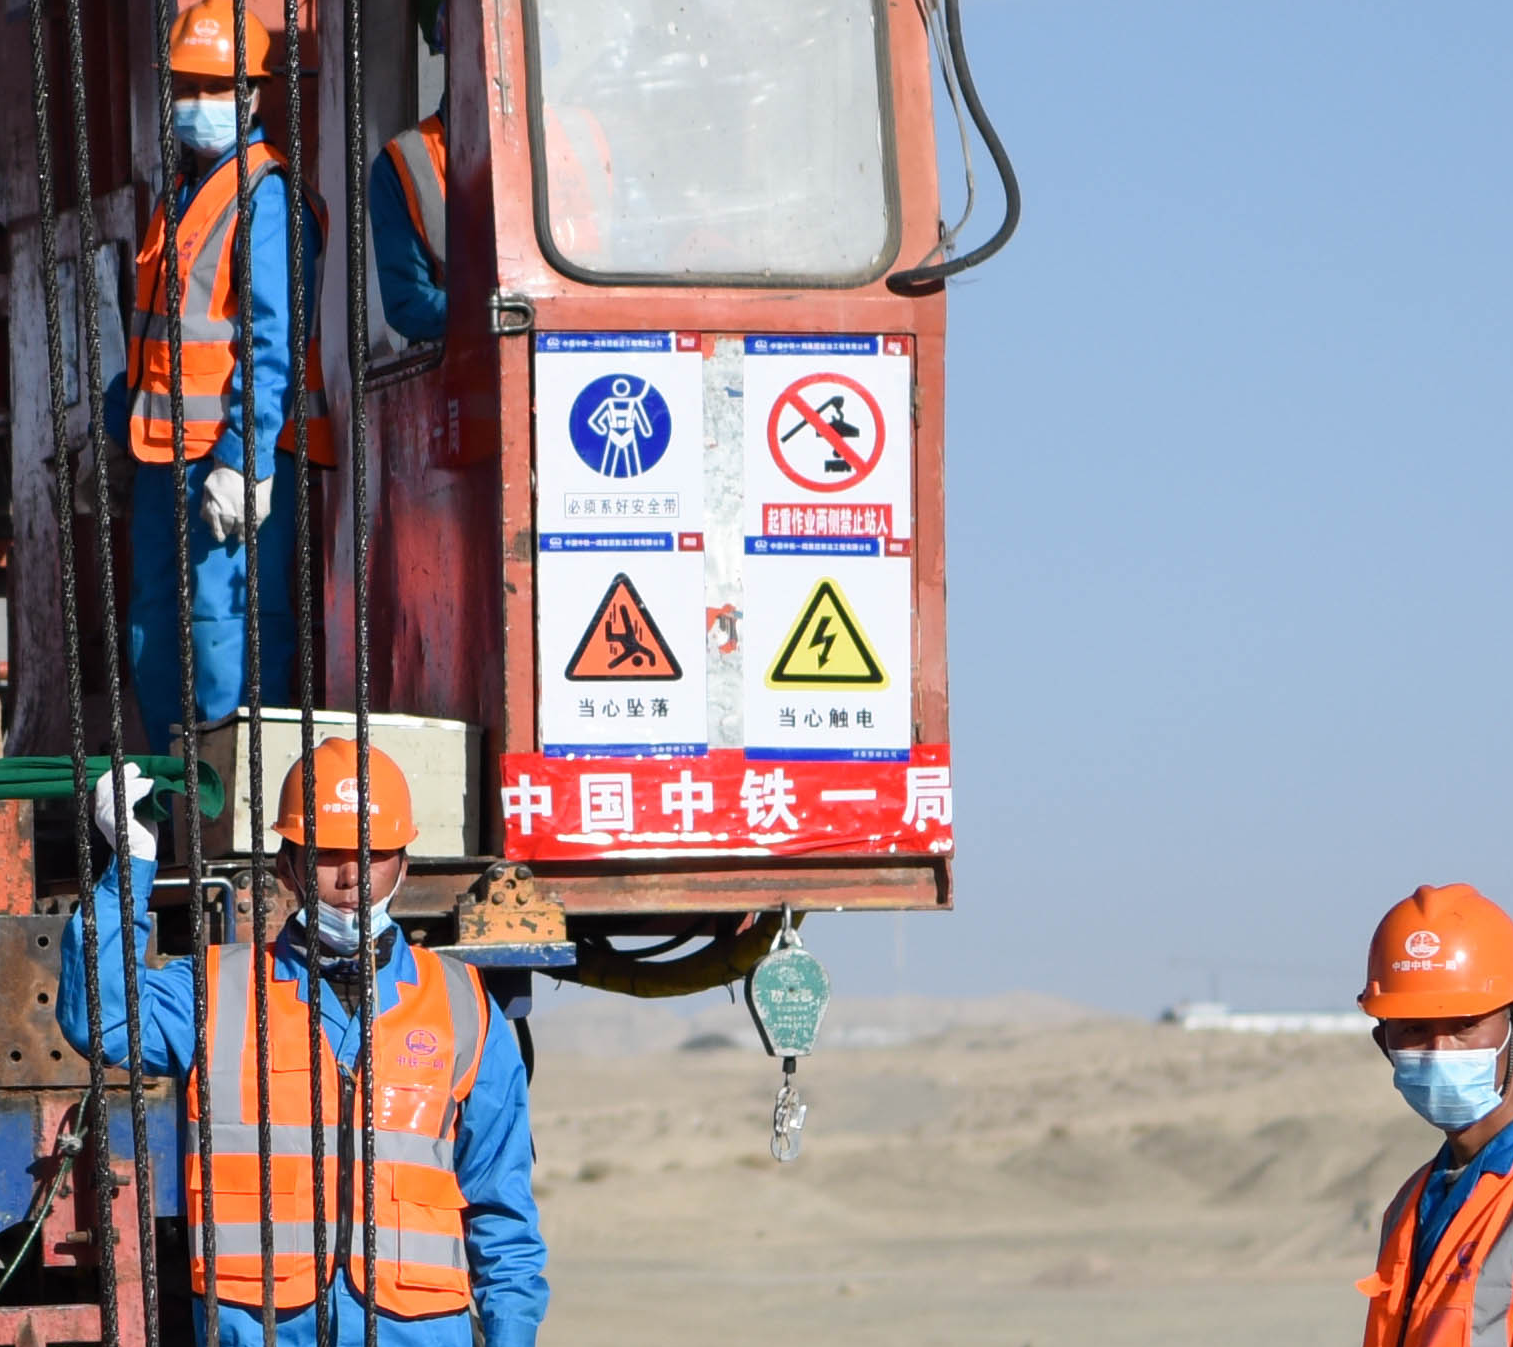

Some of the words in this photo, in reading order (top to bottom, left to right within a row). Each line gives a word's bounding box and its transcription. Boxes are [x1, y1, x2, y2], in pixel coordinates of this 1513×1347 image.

[567, 498, 677, 516] 必须系好安全带
[767, 506, 889, 536] 起重作业两侧禁止站人
[577, 696, 671, 720] 当心坠落
[777, 706, 875, 731] 当心触电
[502, 765, 953, 835] 中国中铁一局
